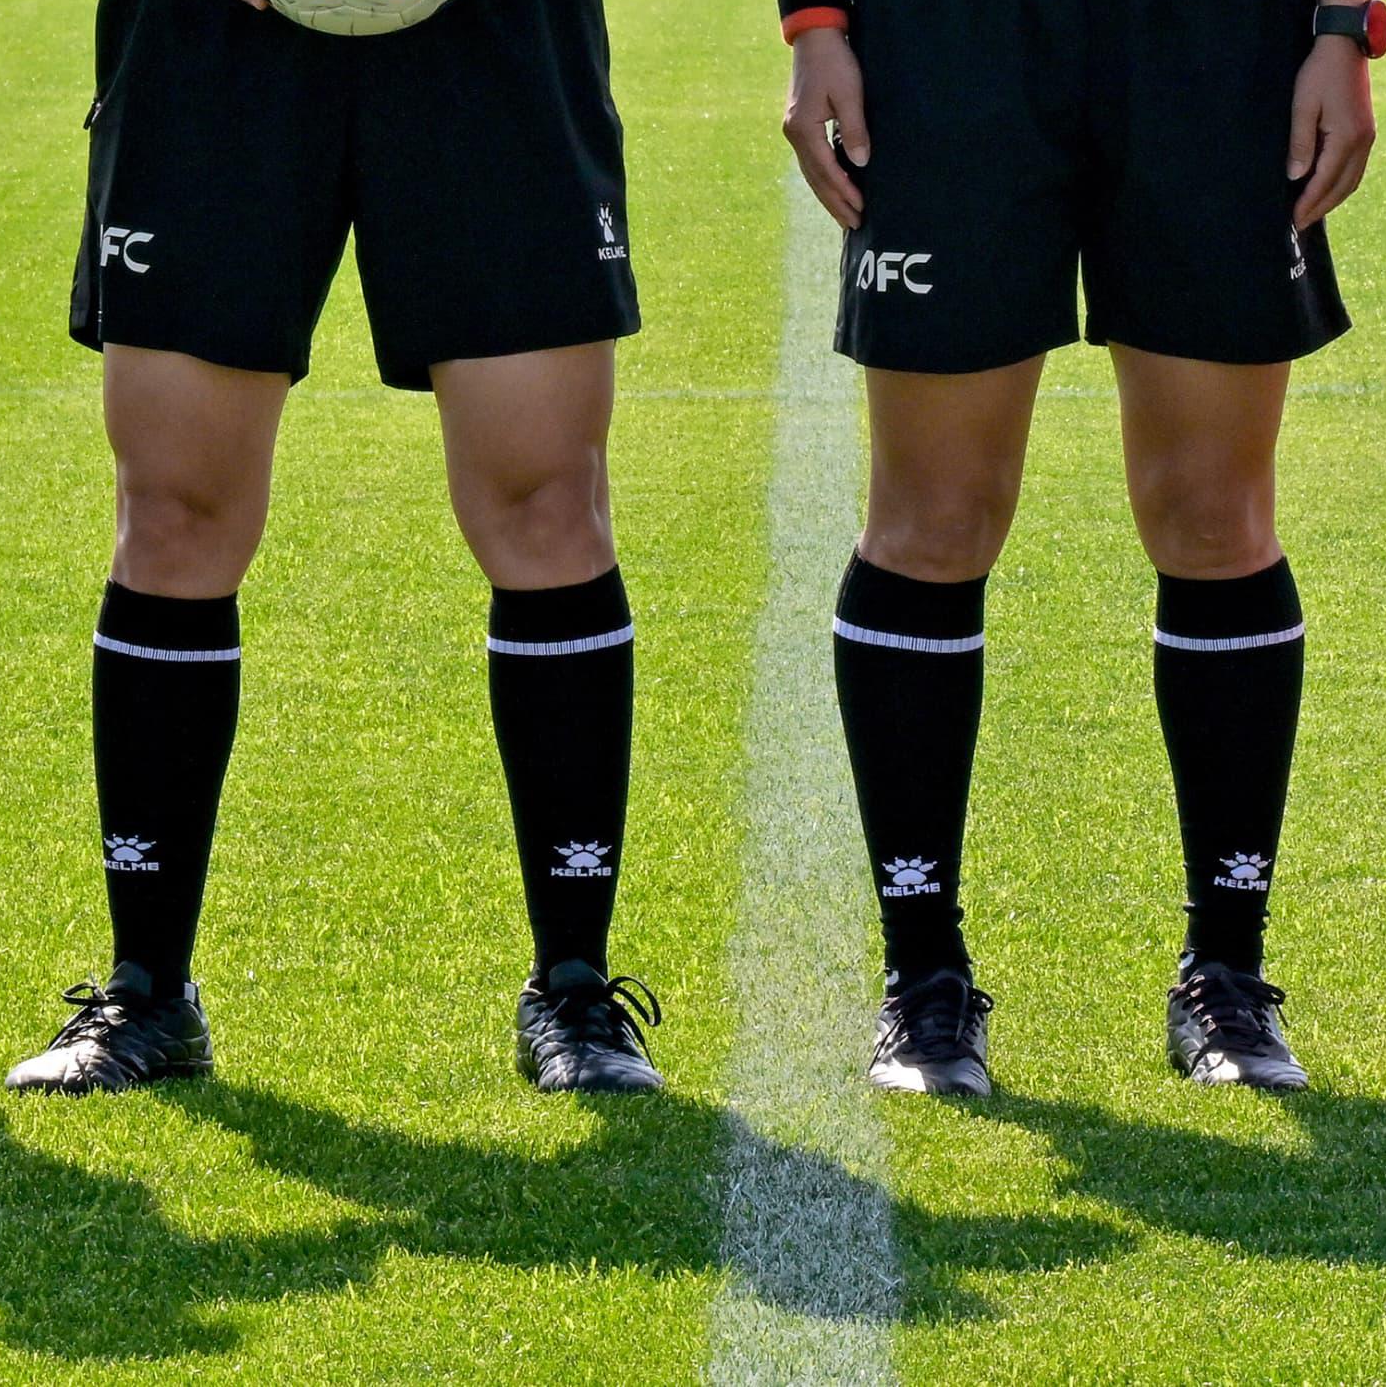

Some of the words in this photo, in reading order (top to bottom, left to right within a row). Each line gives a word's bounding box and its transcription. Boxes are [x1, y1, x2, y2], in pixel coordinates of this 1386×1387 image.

[99, 224, 155, 274] FC
[856, 249, 933, 294] AFC
[103, 859, 159, 872] KELME
[550, 866, 611, 878] KELME
[882, 882, 941, 897] KELME
[1213, 875, 1269, 892] KELME
